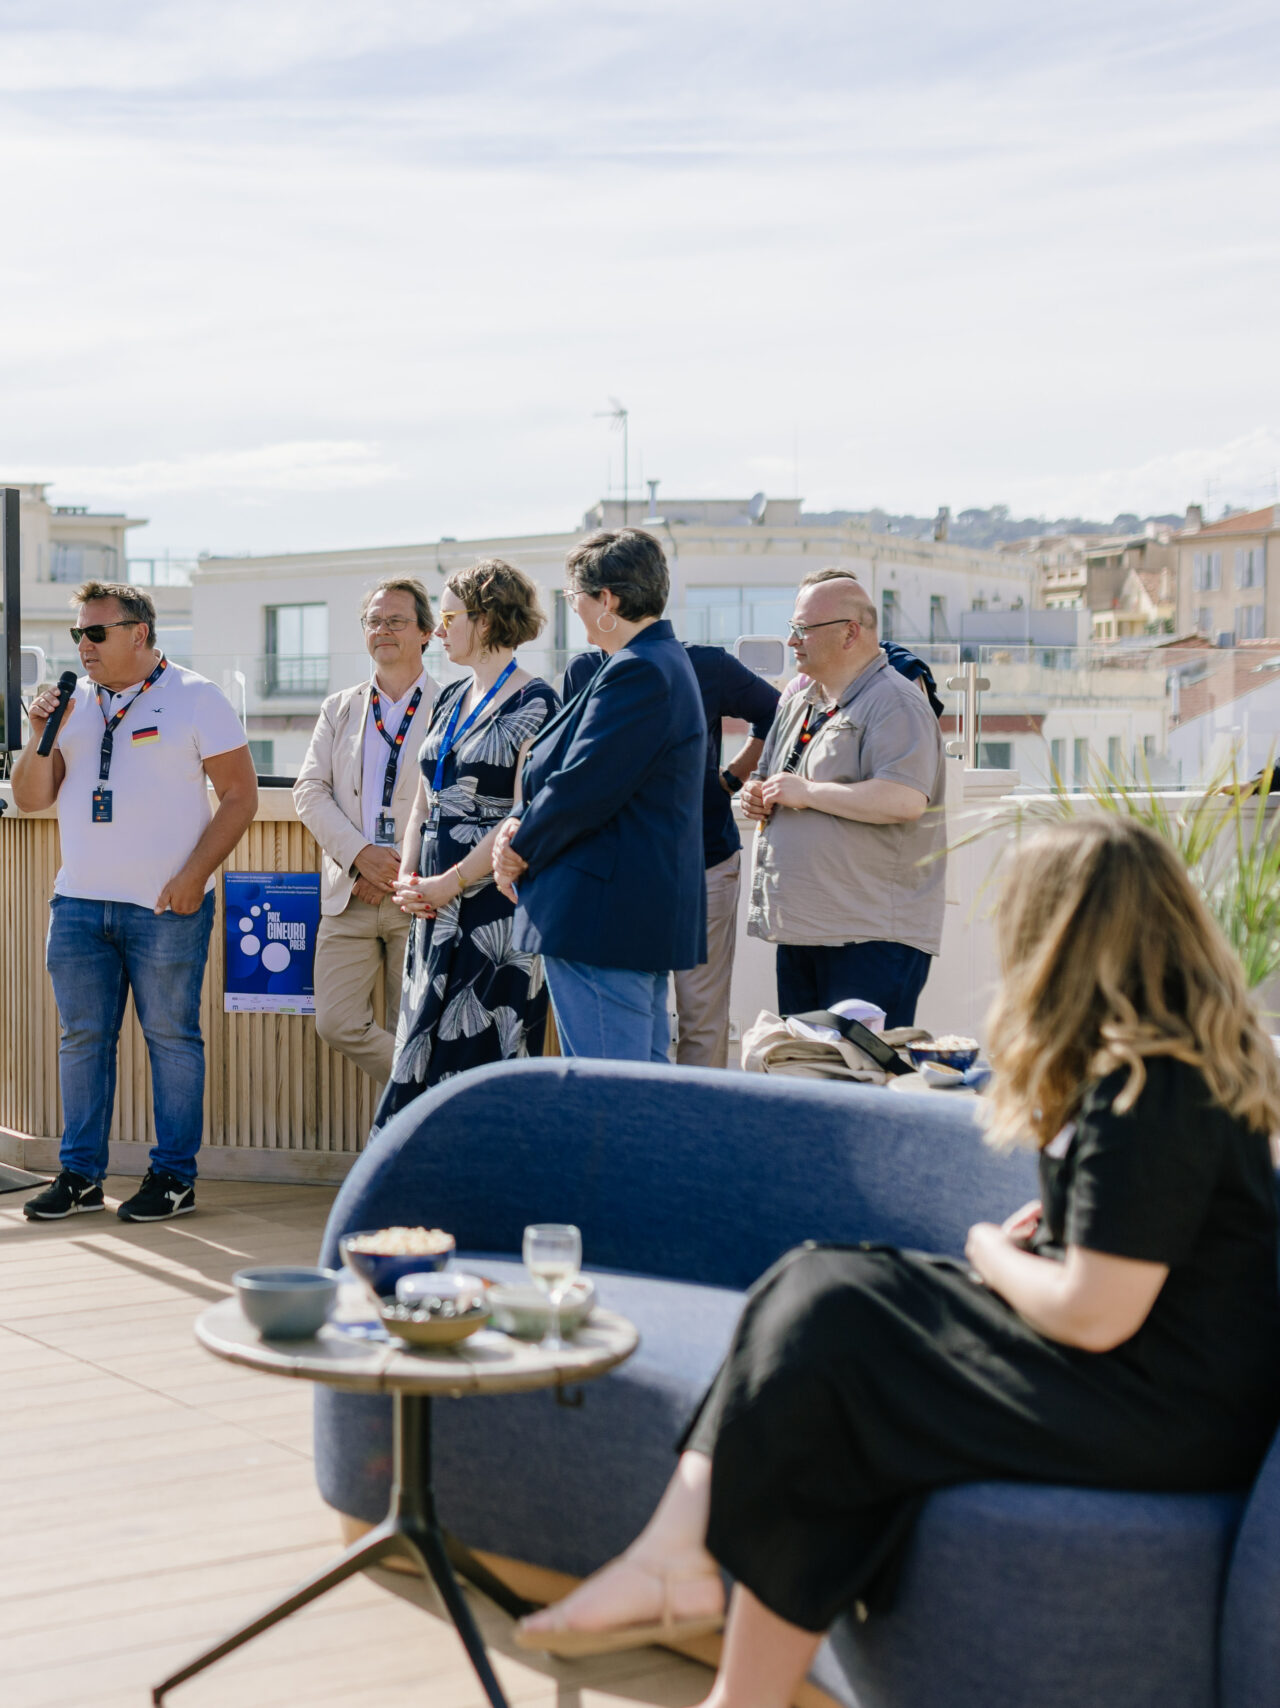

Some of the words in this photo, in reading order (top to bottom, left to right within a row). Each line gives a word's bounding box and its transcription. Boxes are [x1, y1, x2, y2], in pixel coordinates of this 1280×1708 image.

[267, 912, 281, 923] PRIX
[267, 922, 306, 940] CINEURO
[289, 939, 306, 951] PREIS
